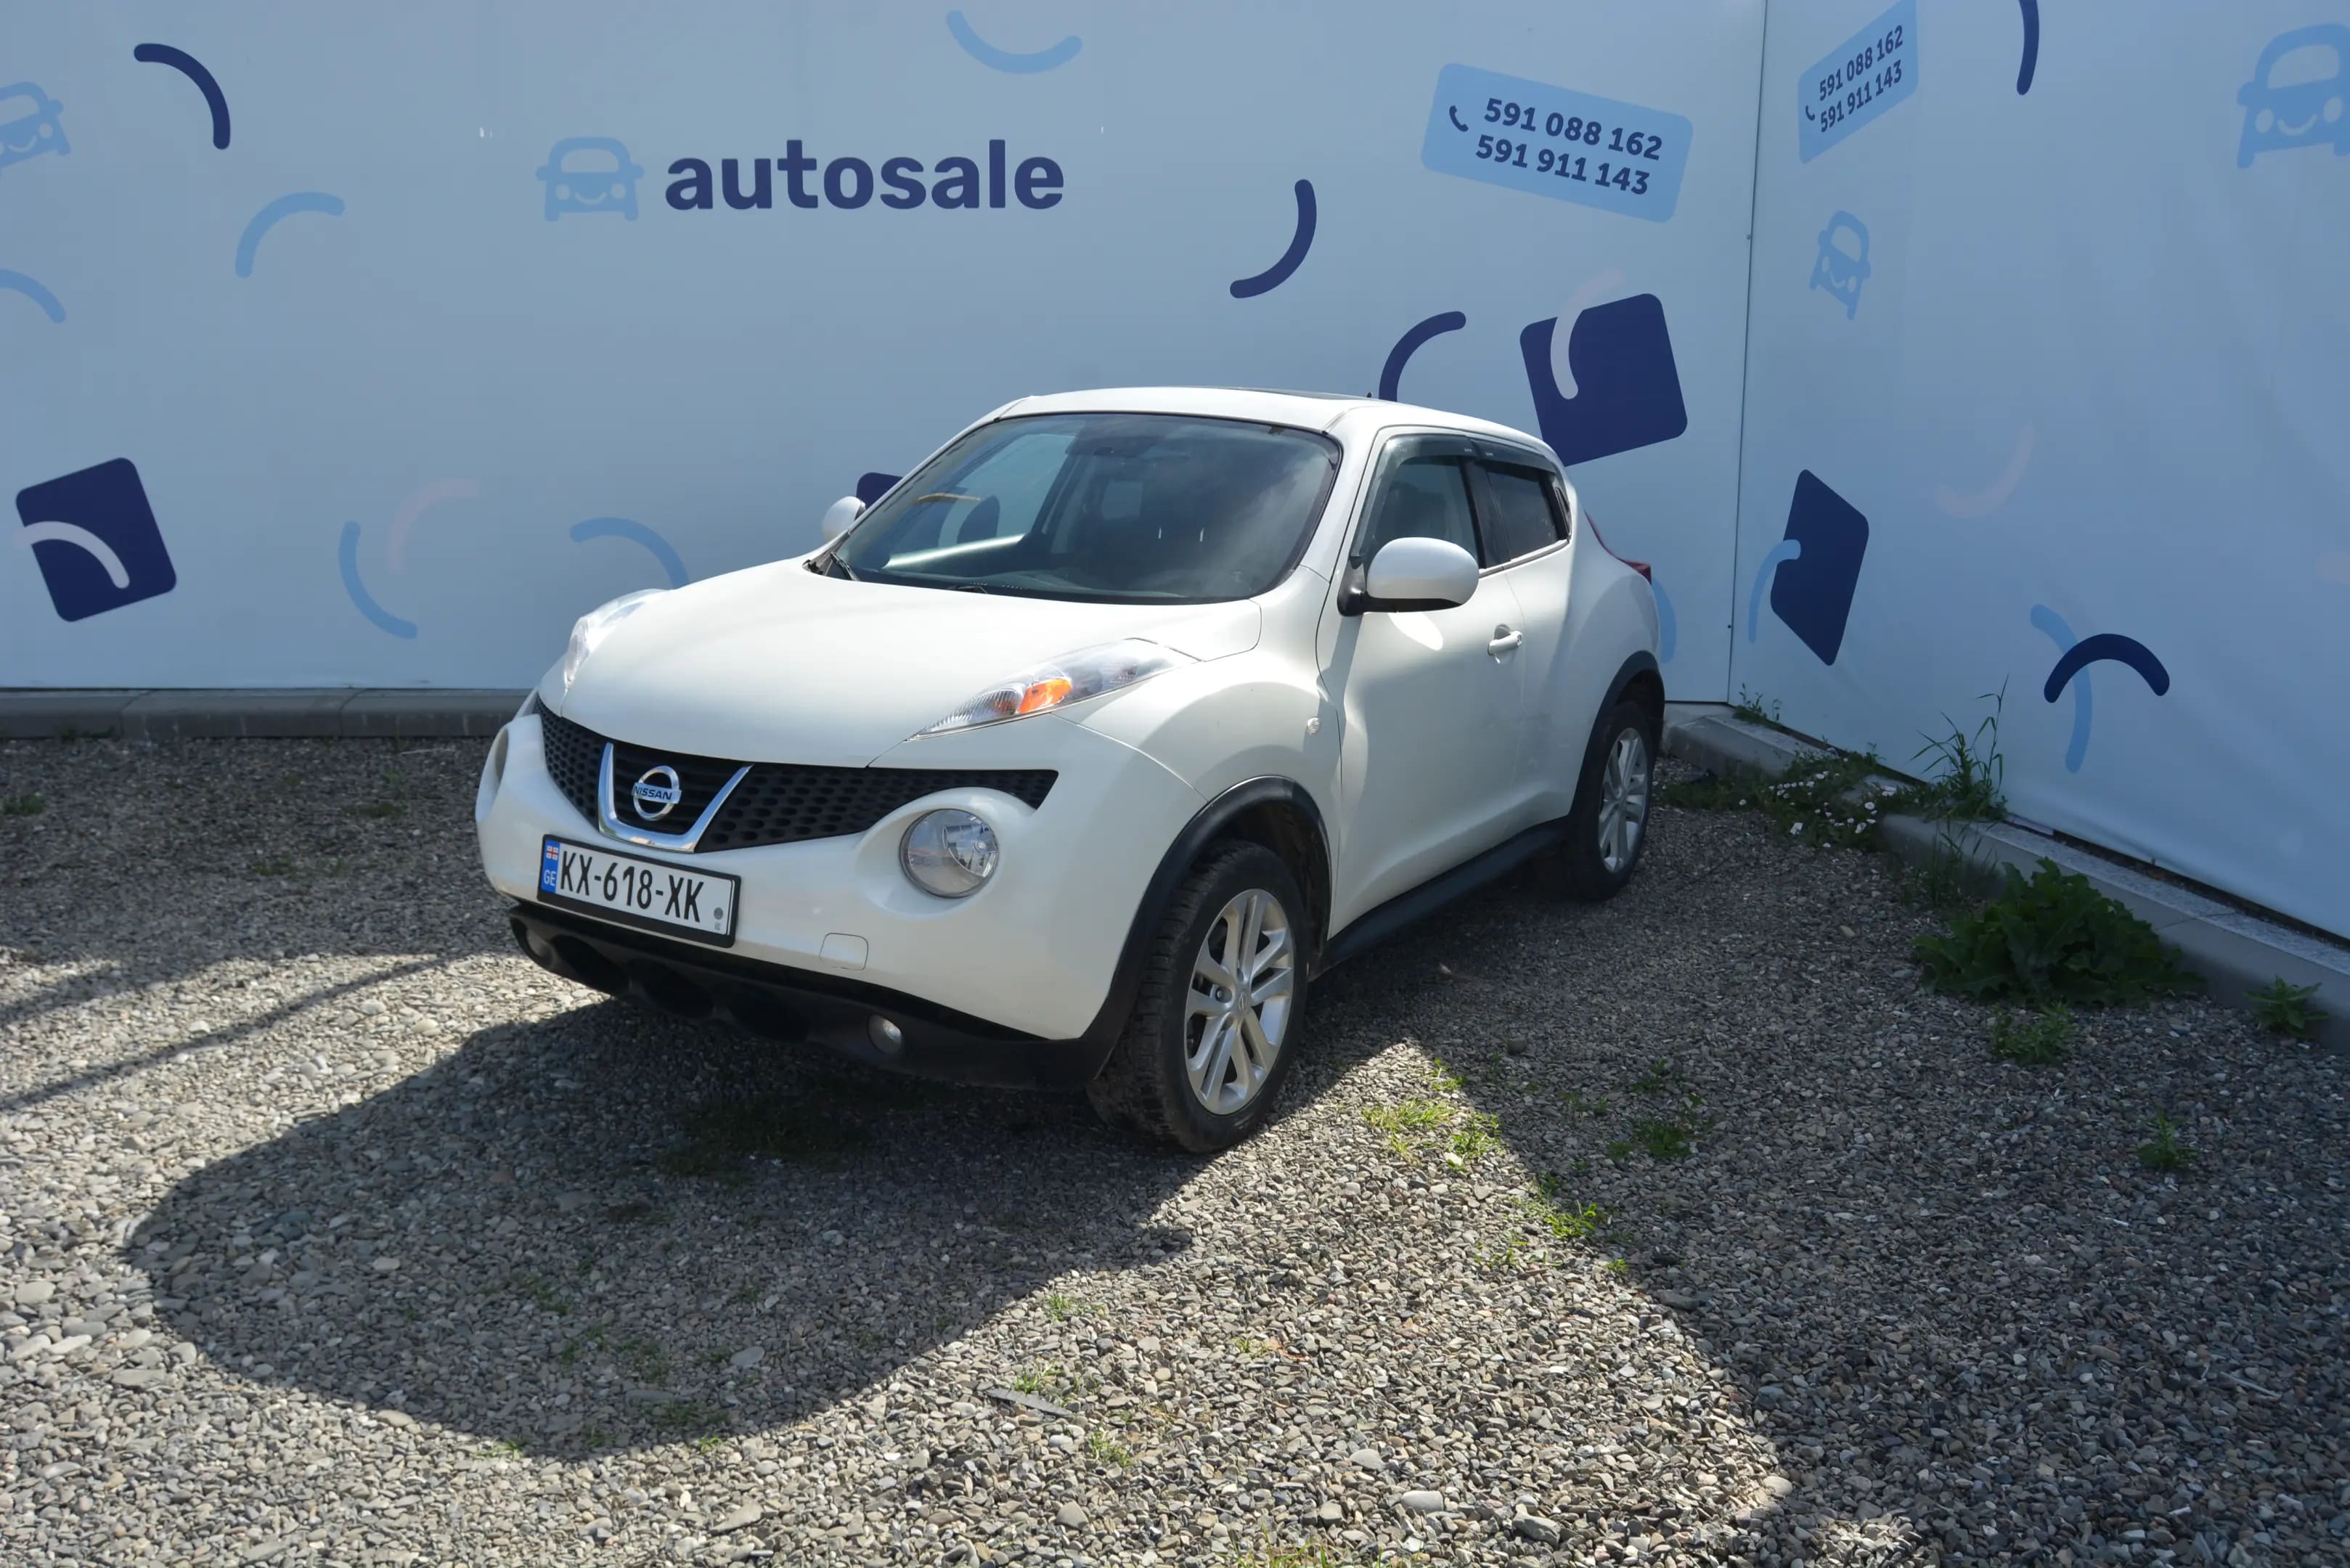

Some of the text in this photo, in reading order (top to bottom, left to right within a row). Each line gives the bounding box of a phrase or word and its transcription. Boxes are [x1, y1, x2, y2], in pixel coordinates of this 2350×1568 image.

[1819, 25, 1903, 101] 591 088 162
[1821, 59, 1902, 132] 591 911 143
[1484, 98, 1662, 160] 591 088 162
[665, 139, 1064, 210] autosale
[1475, 134, 1650, 195] 591 911 143
[633, 785, 672, 801] NISSAN
[544, 870, 557, 886] GE
[560, 851, 704, 923] KX-618-XK
